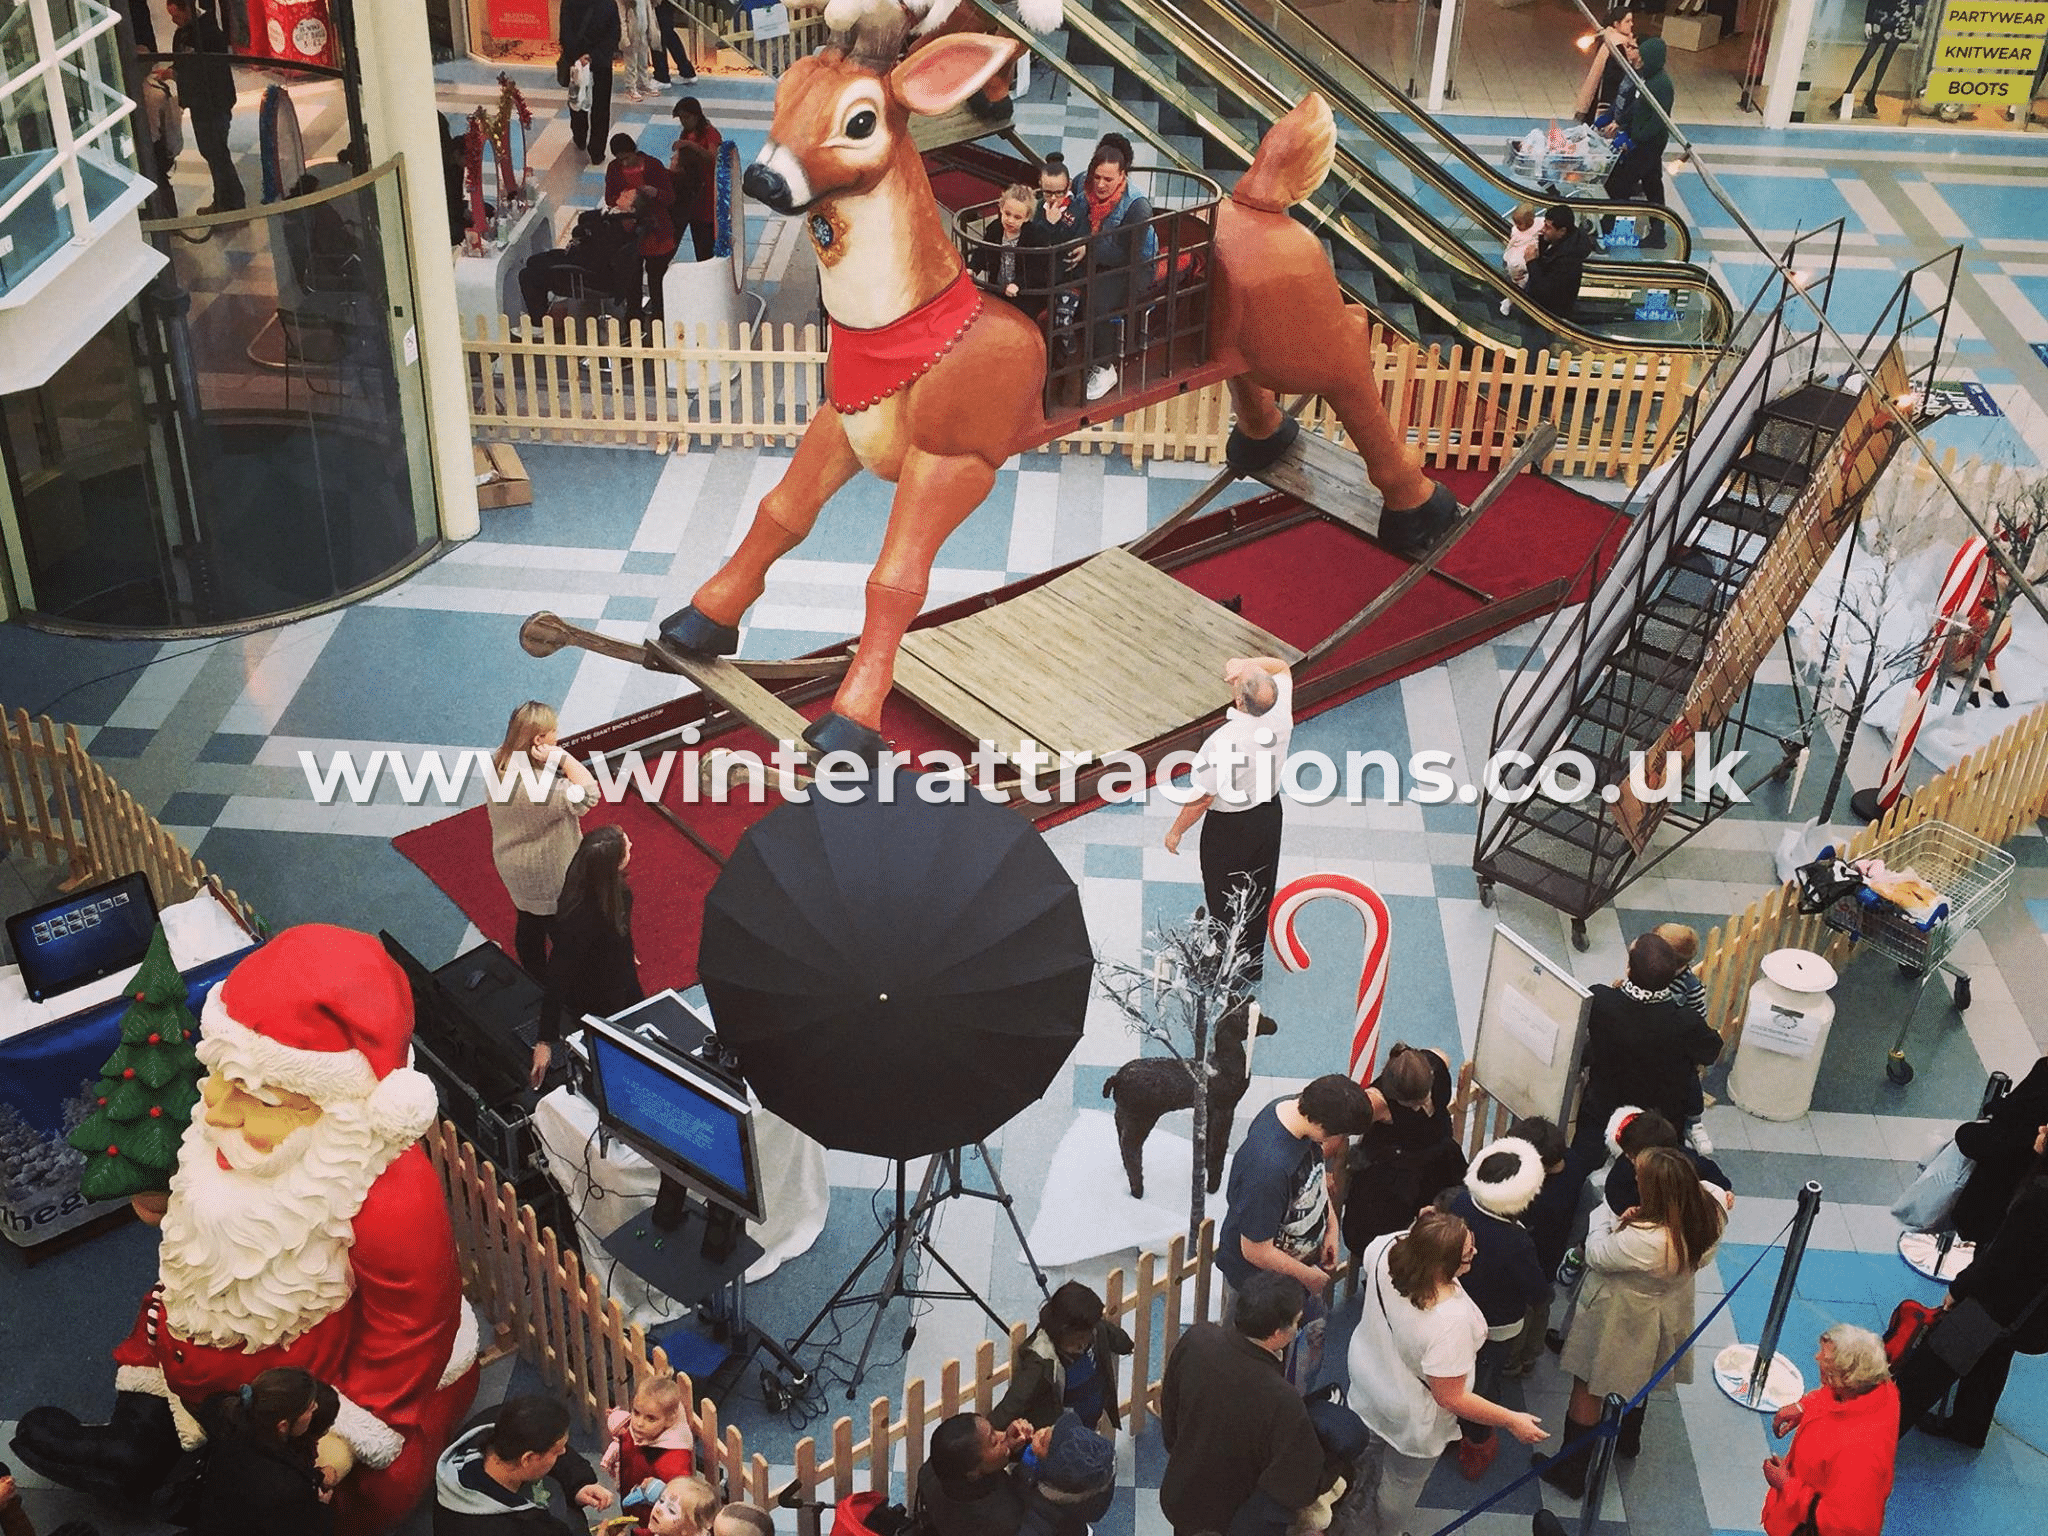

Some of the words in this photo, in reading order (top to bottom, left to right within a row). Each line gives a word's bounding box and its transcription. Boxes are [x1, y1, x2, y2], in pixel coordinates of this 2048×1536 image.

[1949, 10, 2046, 25] PARTYWEAR
[1945, 46, 2032, 60] KNITWEAR
[1948, 81, 2009, 96] BOOTS
